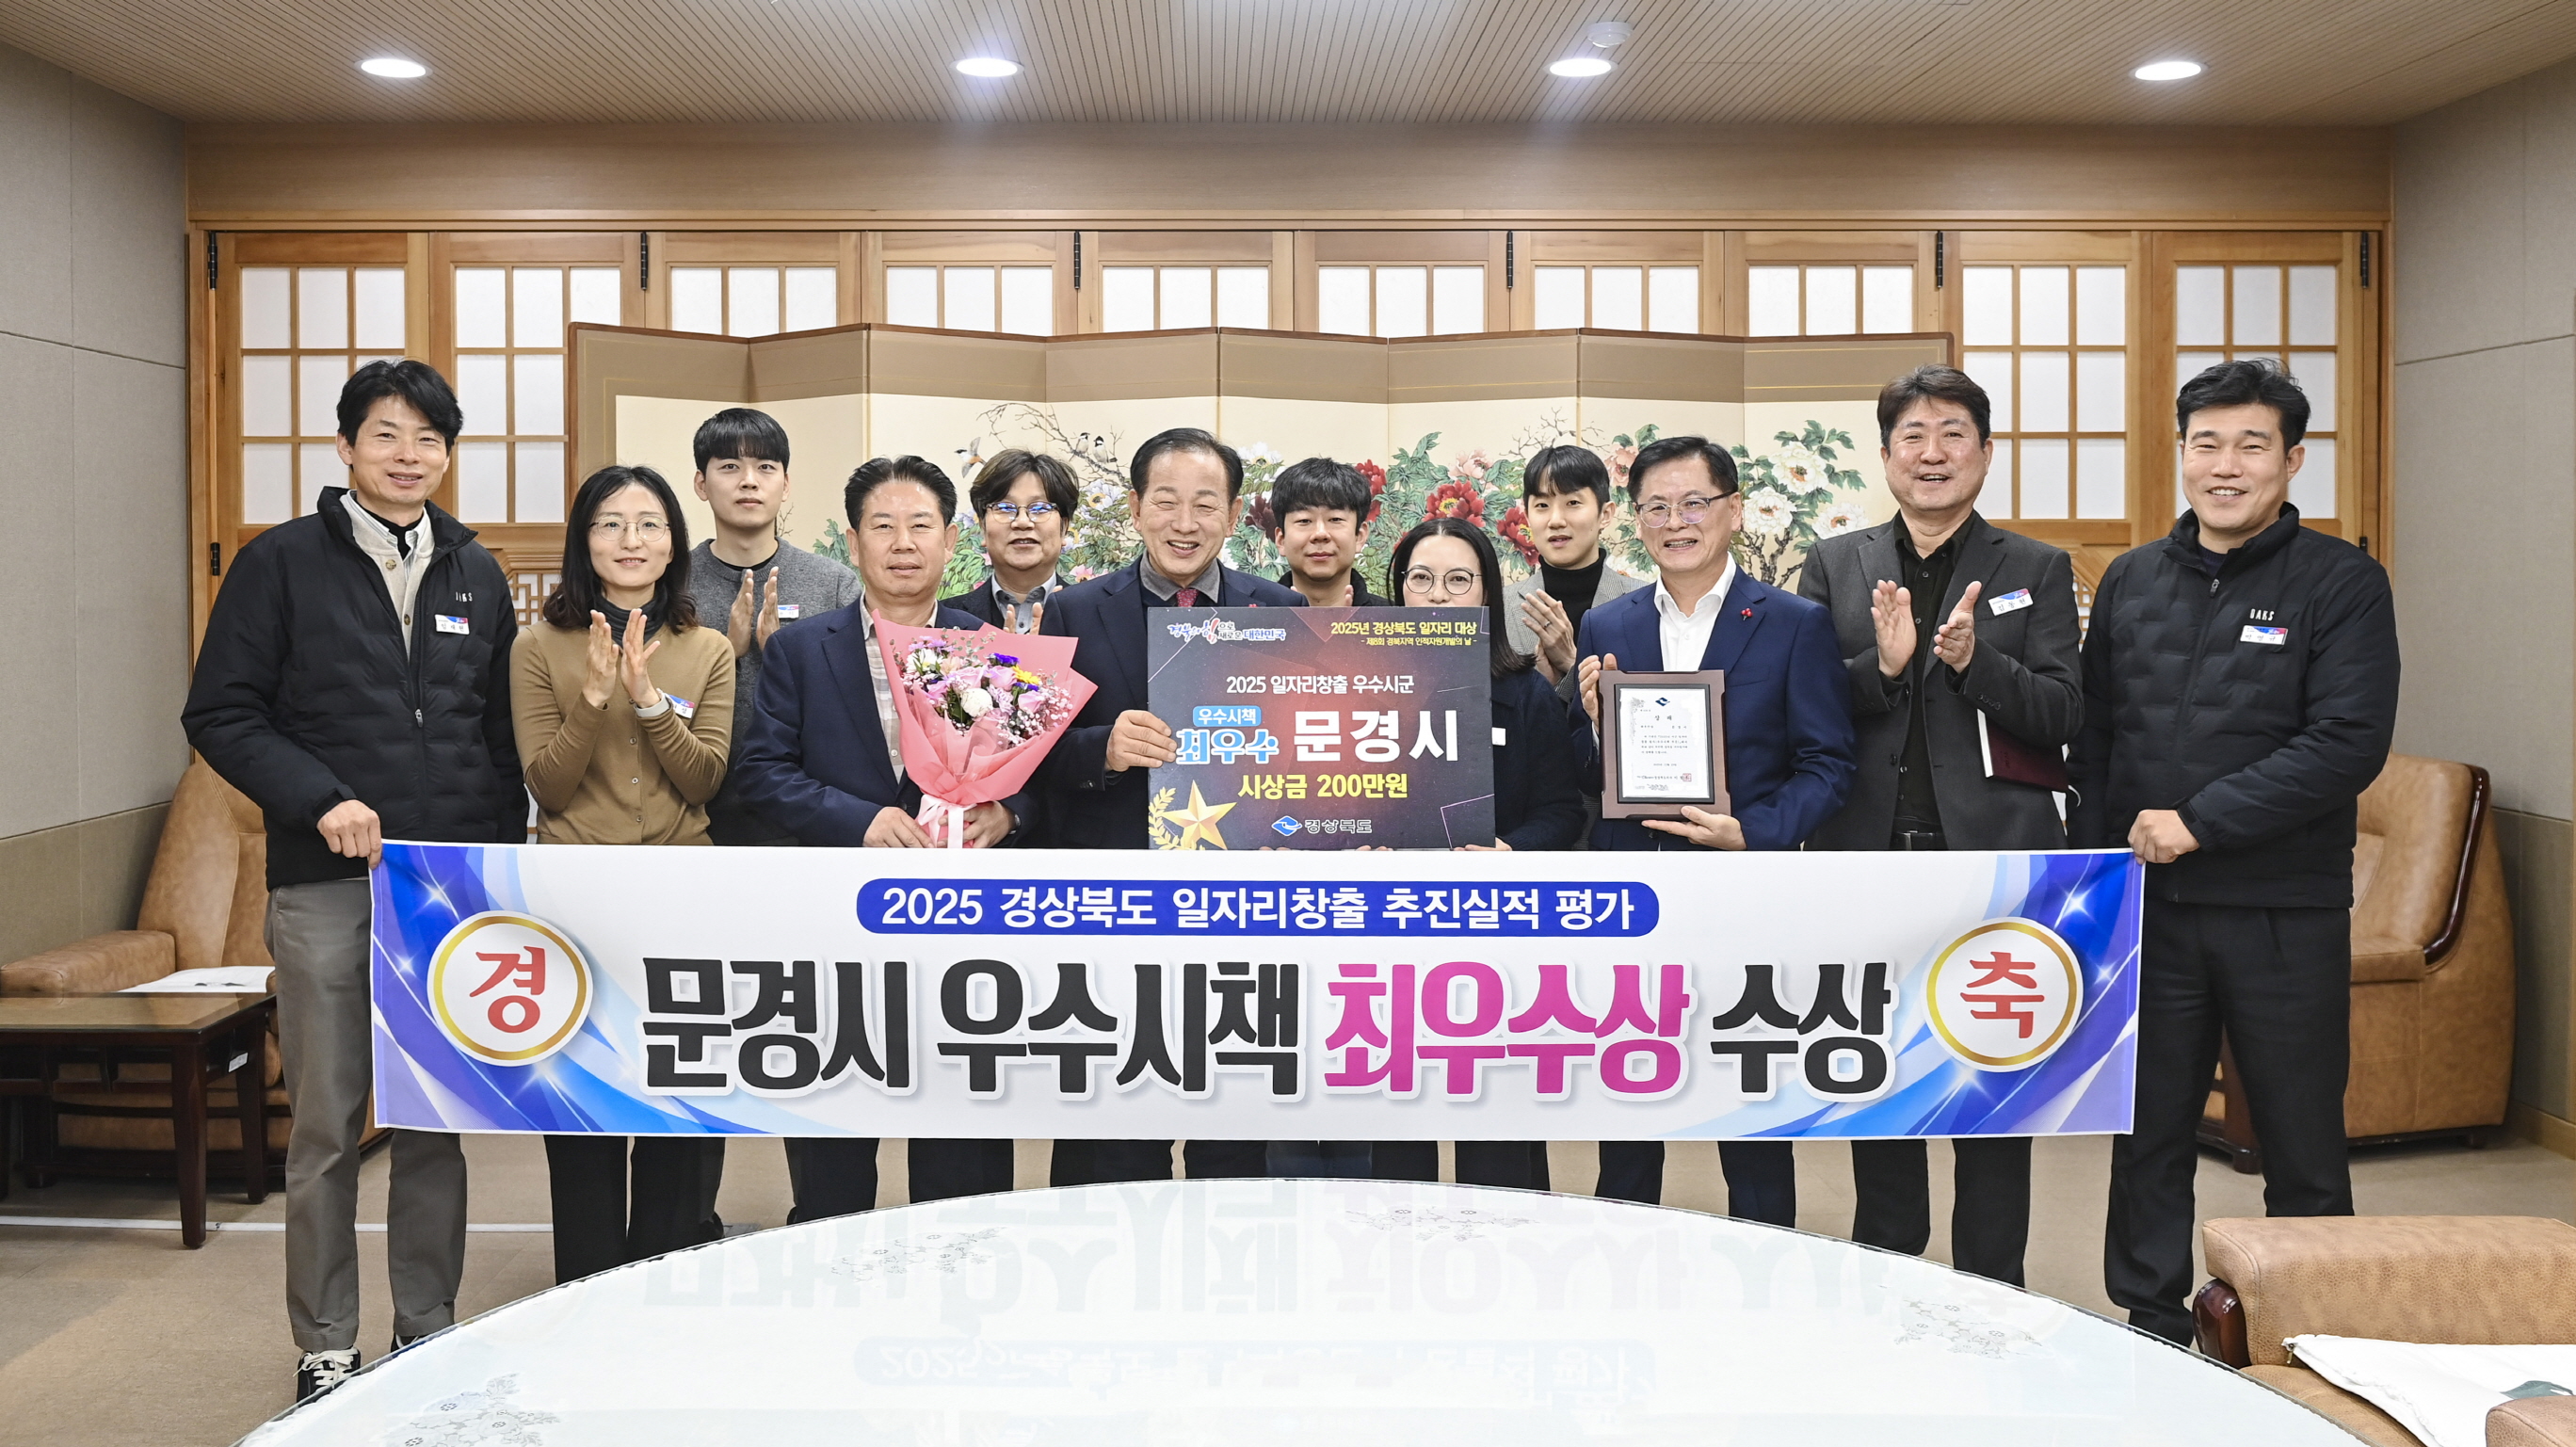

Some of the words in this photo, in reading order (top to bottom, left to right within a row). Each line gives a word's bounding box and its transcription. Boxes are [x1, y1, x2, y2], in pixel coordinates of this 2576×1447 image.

[2249, 608, 2275, 621] OAKS
[1218, 630, 1243, 640] 새로운
[1243, 629, 1286, 641] 대한민국
[1330, 621, 1370, 635] 2025년
[1373, 621, 1416, 635] 경상북도
[1419, 621, 1452, 635] 일자리
[1455, 621, 1477, 635] 대상
[1386, 636, 1414, 646] 경북지역
[1415, 636, 1463, 646] 인적자원개발의
[1465, 636, 1472, 646] 날
[1226, 675, 1267, 694] 2025
[1270, 675, 1349, 695] 일자리창출
[1352, 675, 1415, 695] 우수시군
[1198, 708, 1257, 725] 우수시책
[1176, 729, 1280, 764] 최우수
[1294, 710, 1458, 763] 문경시
[1238, 773, 1308, 800] 시상금
[1316, 773, 1409, 799] 200만원
[1304, 819, 1373, 834] 경상북도
[881, 887, 983, 925] 2025
[999, 886, 1157, 928] 경상북도
[1172, 886, 1369, 929] 일자리창출
[1382, 886, 1539, 929] 추진실적
[1555, 886, 1634, 929] 평가
[470, 945, 546, 1034] 경
[1960, 951, 2046, 1039] 축
[642, 957, 910, 1090] 문경시
[937, 958, 1299, 1096] 우수시책
[1325, 961, 1690, 1095] 최우수상
[1710, 962, 1892, 1094] 수상
